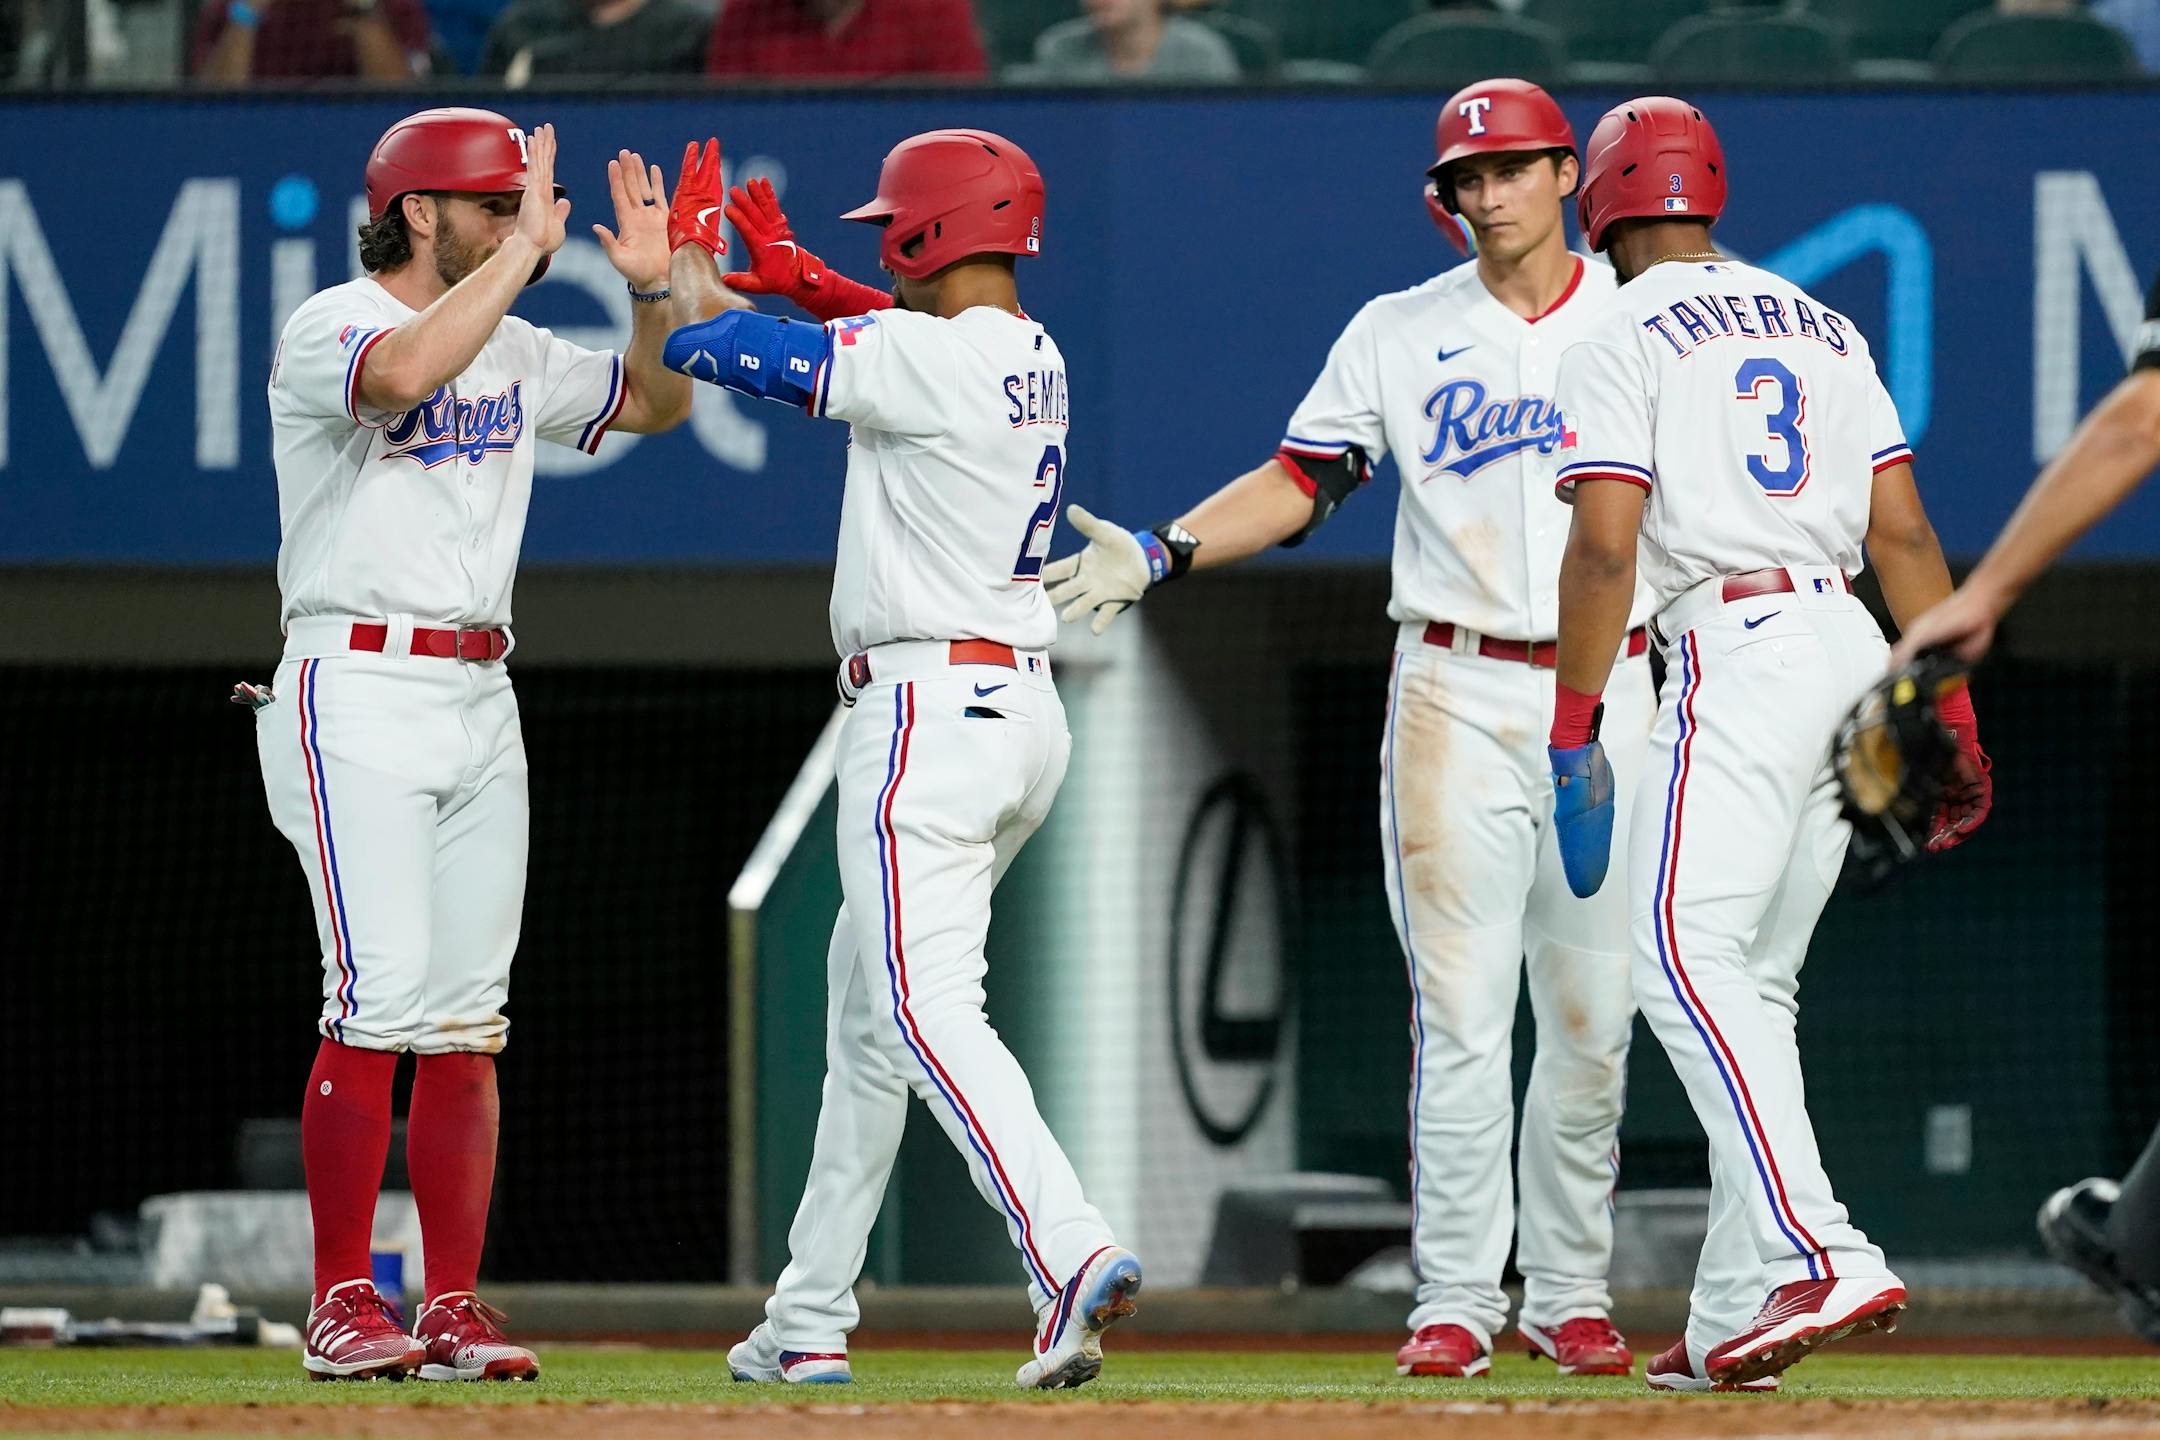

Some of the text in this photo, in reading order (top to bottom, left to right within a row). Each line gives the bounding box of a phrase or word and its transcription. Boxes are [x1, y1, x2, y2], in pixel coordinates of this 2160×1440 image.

[1459, 97, 1490, 136] T
[1669, 174, 1682, 193] 3
[1031, 216, 1040, 237] 2
[1642, 294, 1848, 359] TAVERAS
[740, 353, 760, 370] 2
[790, 356, 810, 373] 2
[1734, 358, 1811, 497] 3
[1011, 445, 1063, 581] 2
